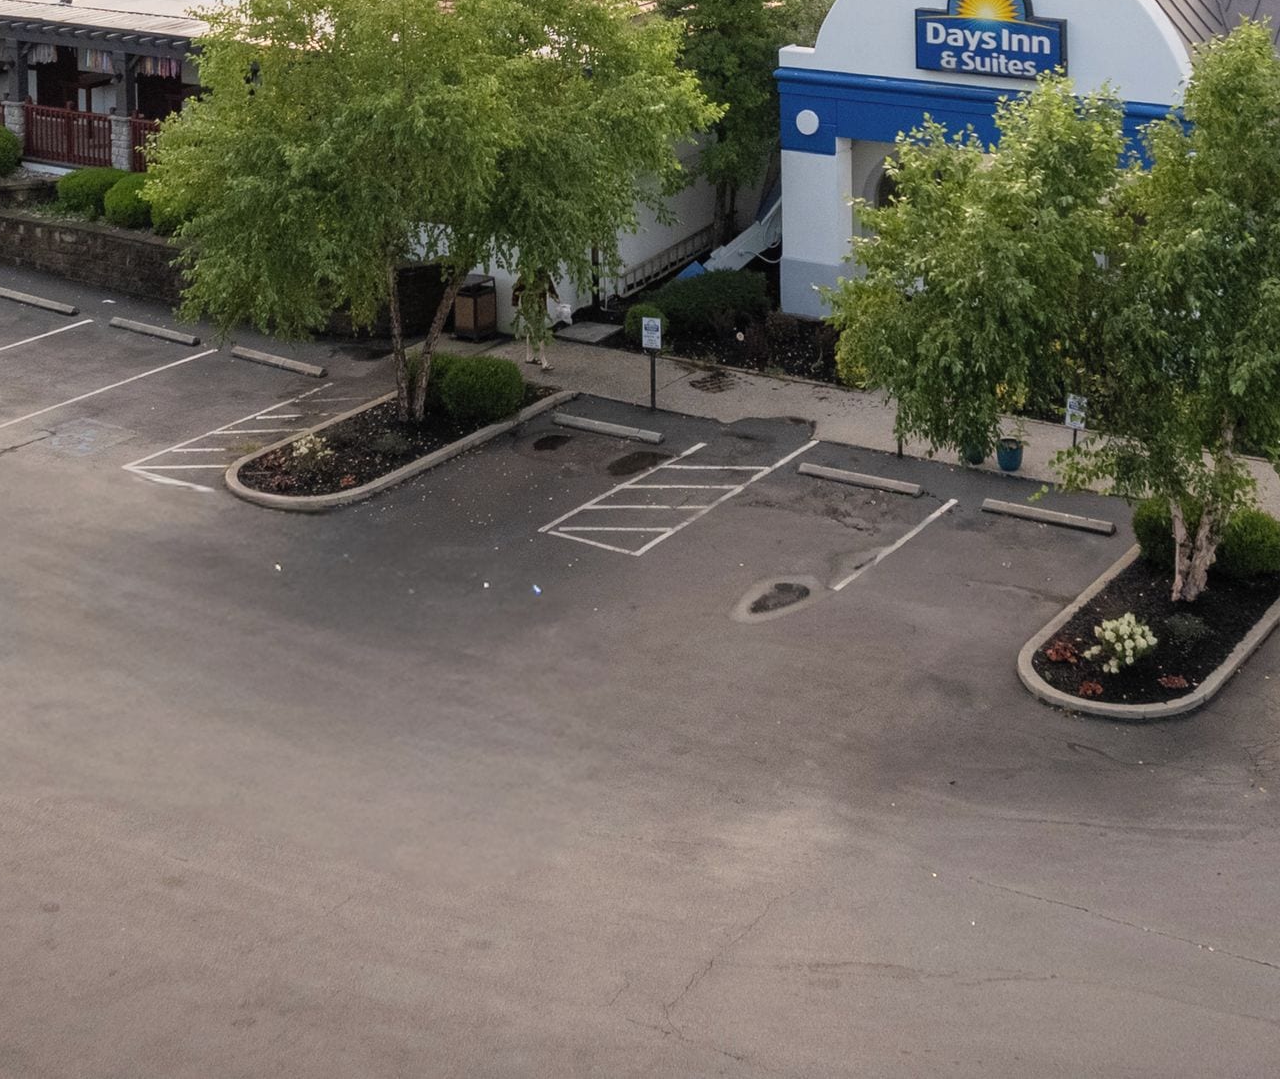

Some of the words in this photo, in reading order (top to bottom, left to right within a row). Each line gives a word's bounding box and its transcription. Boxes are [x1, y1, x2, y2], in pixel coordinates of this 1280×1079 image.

[926, 22, 997, 51] Days
[1001, 28, 1051, 54] Inn
[940, 50, 958, 69] &
[961, 51, 1037, 76] Suites
